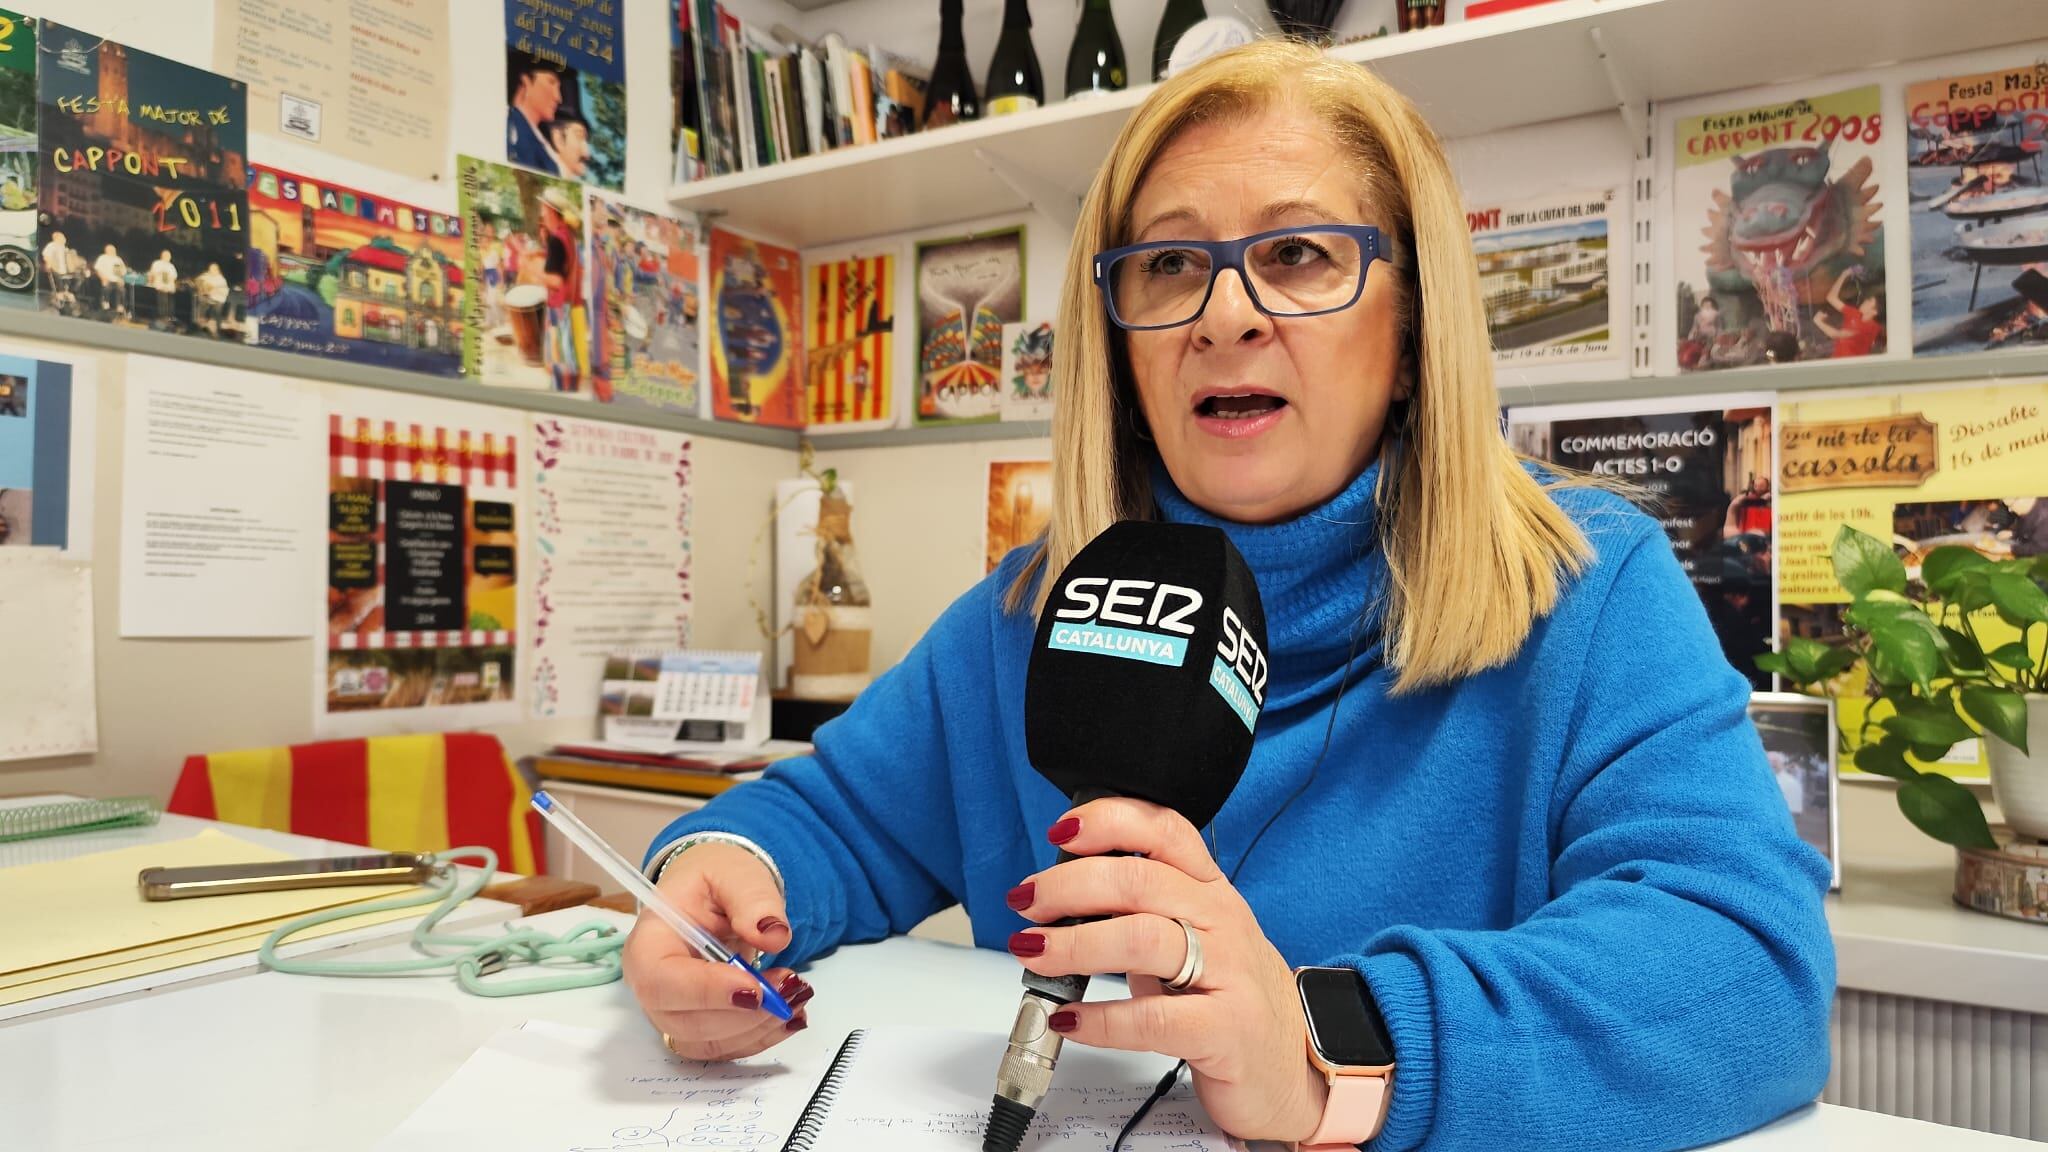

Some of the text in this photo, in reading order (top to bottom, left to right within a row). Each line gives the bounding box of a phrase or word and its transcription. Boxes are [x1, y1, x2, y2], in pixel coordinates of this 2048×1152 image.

[541, 20, 565, 45] 17
[586, 36, 613, 64] 24
[1949, 73, 2048, 100] Festa Majo
[57, 94, 231, 126] FESTA MAJOR DE
[1702, 115, 1744, 132] FESTA
[1686, 112, 1882, 156] CAPPONT 2008
[53, 146, 188, 180] CAPPONT
[152, 197, 241, 232] 2011
[1466, 208, 1501, 233] ONT
[1527, 211, 1537, 224] LA
[1539, 208, 1566, 222] CIUTAT
[1568, 205, 1583, 218] DEL
[937, 383, 1001, 406] CAPPON
[1560, 426, 1716, 454] COMMEMORACIÓ
[1817, 428, 1847, 449] nit
[1853, 426, 1880, 445] de
[1887, 422, 1919, 443] la
[1950, 405, 2040, 443] Dissabte
[1782, 445, 1922, 479] cassola
[1950, 428, 2048, 470] 16 de mai
[1591, 457, 1648, 475] ACTES
[1056, 577, 1204, 635] SER
[1055, 629, 1175, 660] CATALUNYA
[1217, 605, 1268, 705] SER
